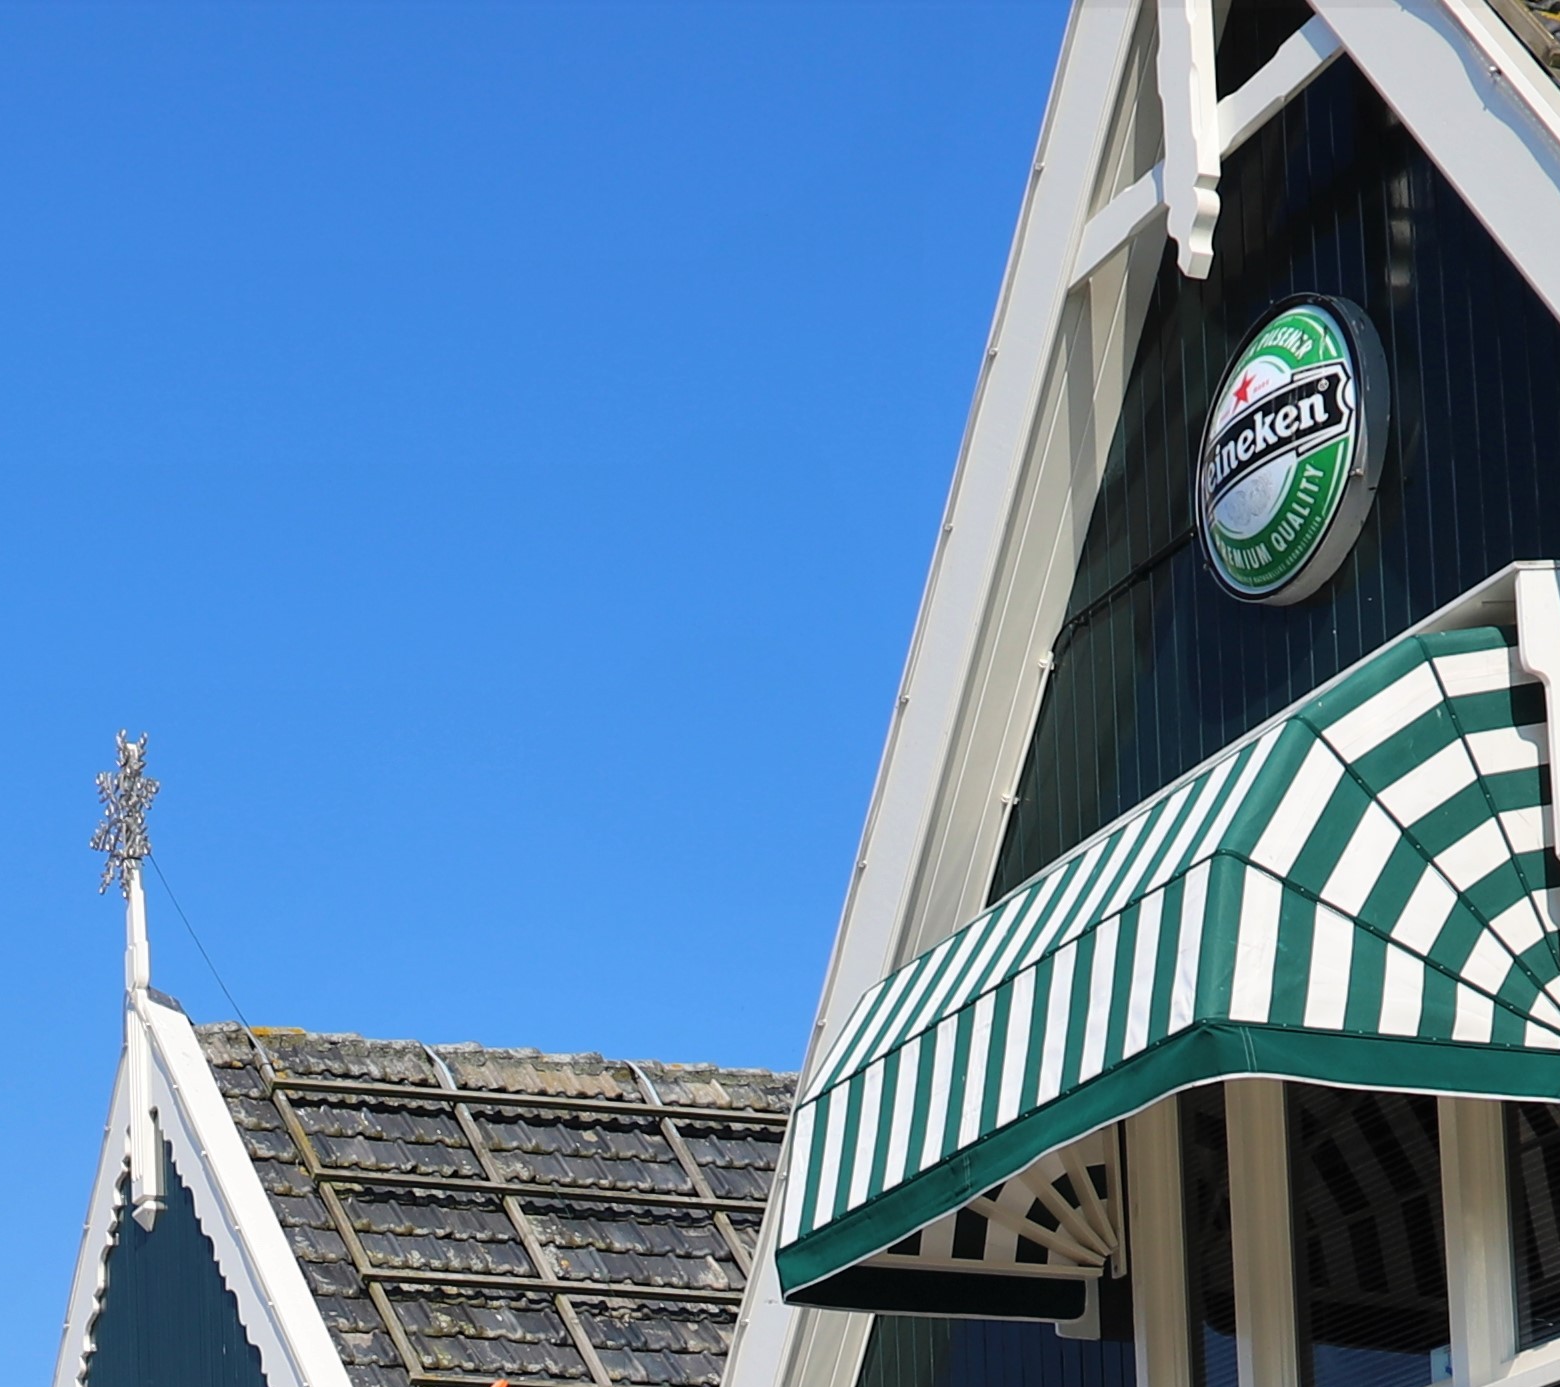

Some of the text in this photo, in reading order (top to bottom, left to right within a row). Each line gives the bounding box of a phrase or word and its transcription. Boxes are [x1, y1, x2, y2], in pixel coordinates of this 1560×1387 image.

[1205, 393, 1329, 494] eineken
[1213, 462, 1324, 570] PREMIUM QUALITY
